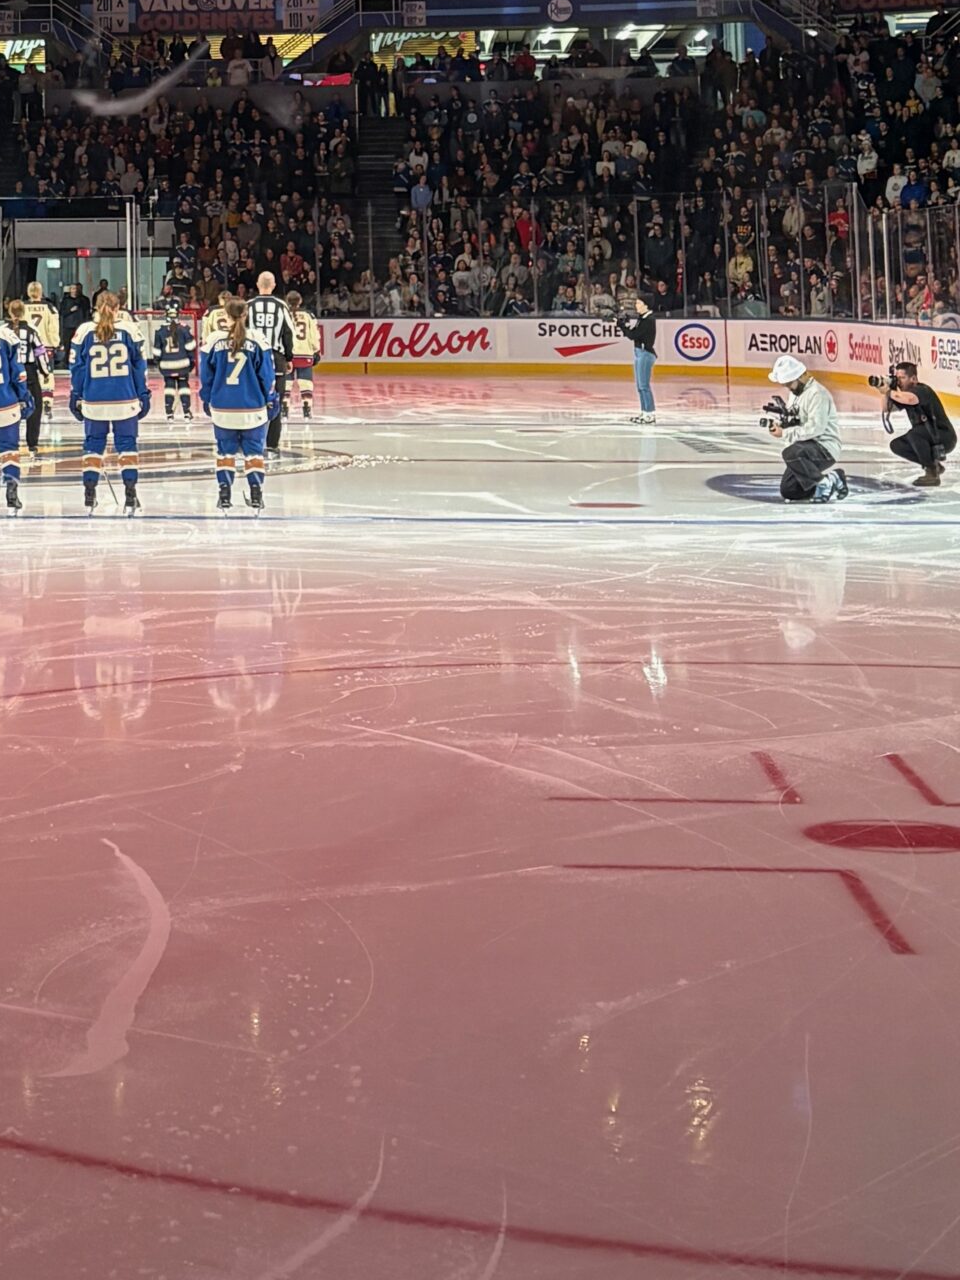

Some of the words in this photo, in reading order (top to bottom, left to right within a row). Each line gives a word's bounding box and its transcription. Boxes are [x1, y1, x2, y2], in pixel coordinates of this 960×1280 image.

[138, 11, 276, 31] GOLDENEYES
[31, 314, 43, 327] 7
[256, 314, 274, 327] 98
[537, 322, 623, 338] SPORTCHE
[334, 322, 490, 358] Molson
[748, 333, 823, 355] AEROPLAN
[848, 333, 884, 366] Scotiabank
[90, 343, 130, 378] 22
[226, 352, 248, 385] 7
